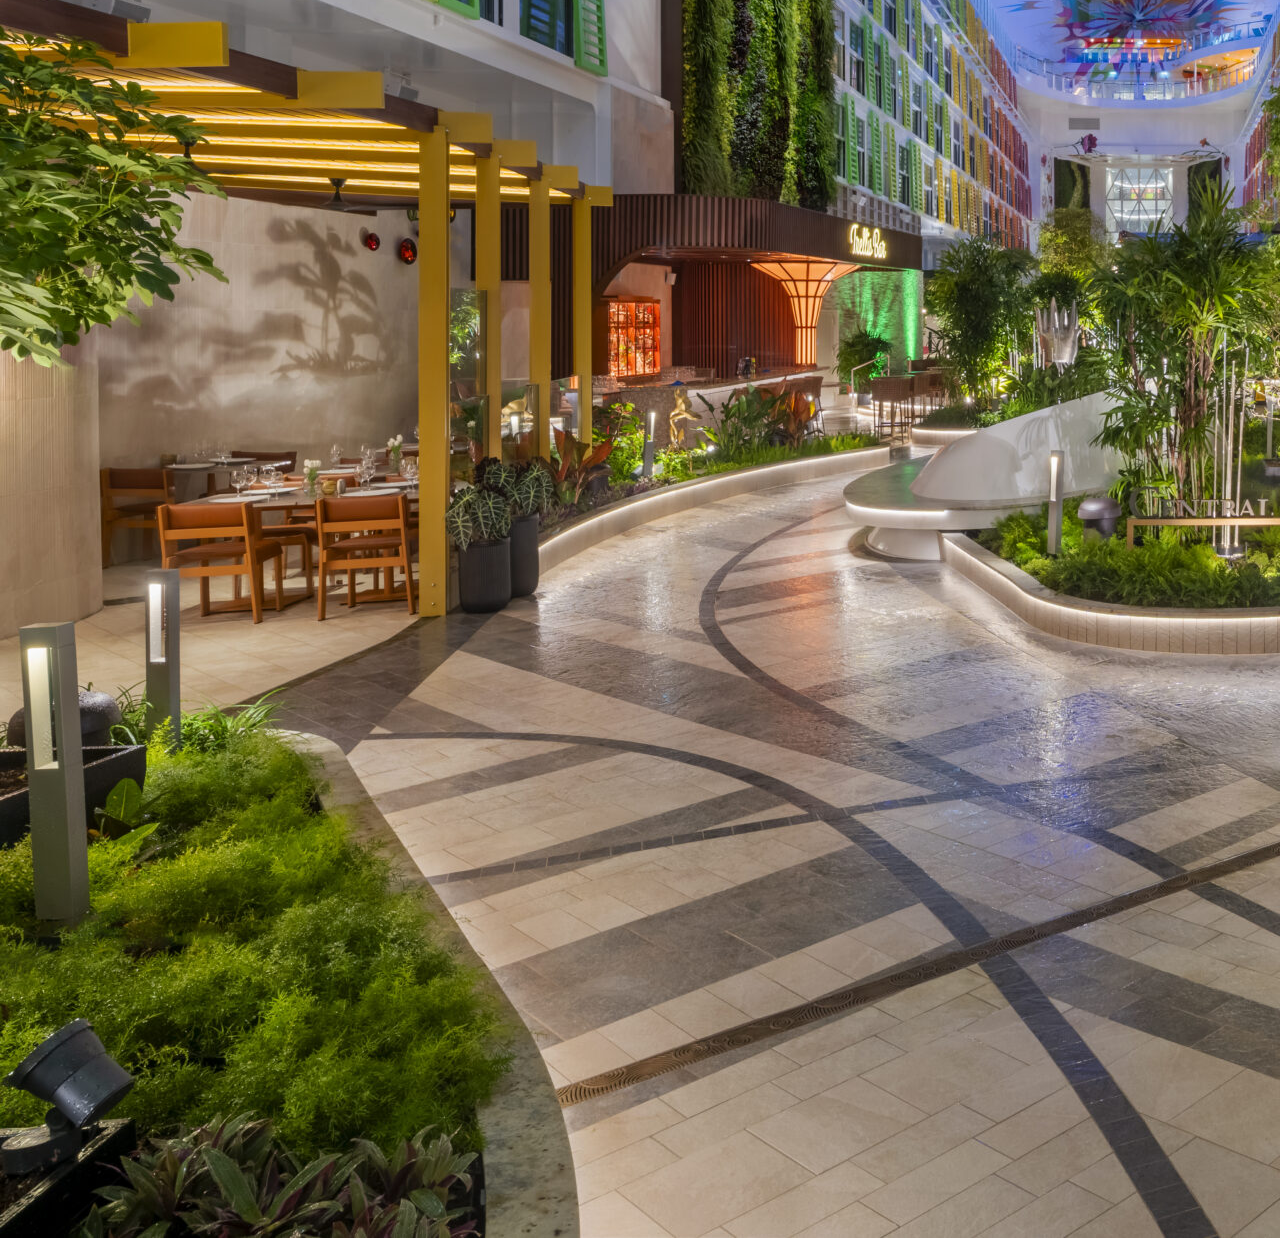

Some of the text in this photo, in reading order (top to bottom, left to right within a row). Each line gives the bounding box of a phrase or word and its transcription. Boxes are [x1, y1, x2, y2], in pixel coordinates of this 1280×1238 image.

[850, 223, 887, 259] Trellis Bar
[1129, 486, 1274, 517] CENTRAL
